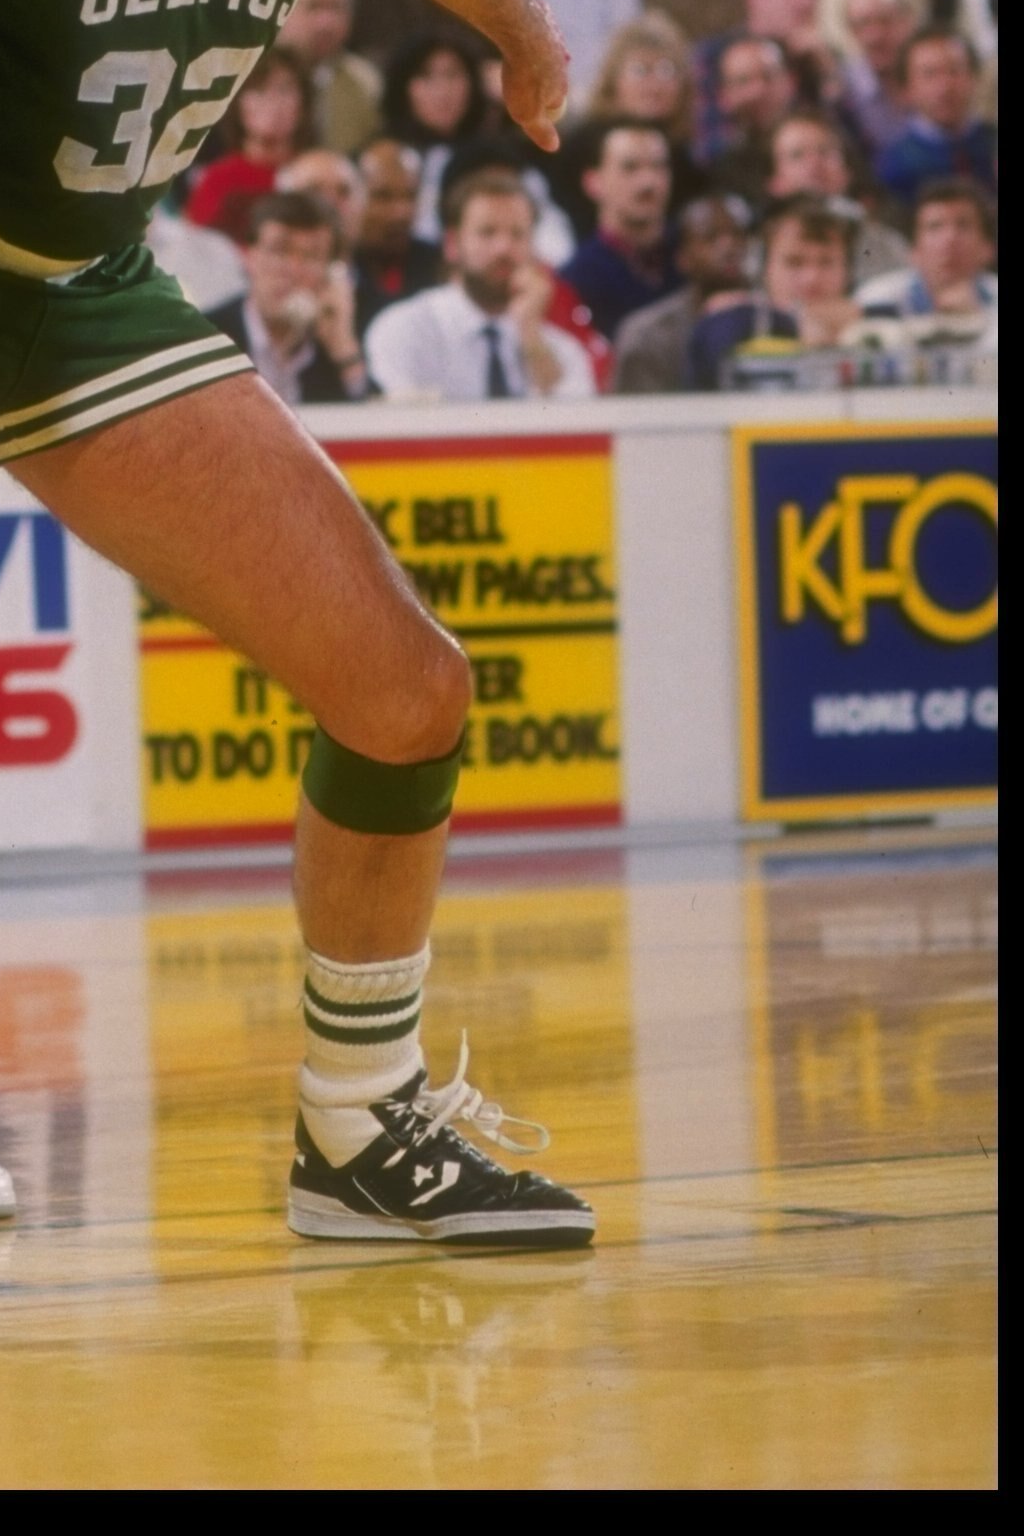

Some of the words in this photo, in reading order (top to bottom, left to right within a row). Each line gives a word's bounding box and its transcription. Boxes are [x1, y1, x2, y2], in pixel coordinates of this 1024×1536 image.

[52, 44, 266, 194] 32
[413, 496, 504, 546] BELL
[812, 693, 917, 736] HOME
[921, 689, 967, 732] OF
[147, 731, 201, 782] TO
[212, 729, 275, 779] DO
